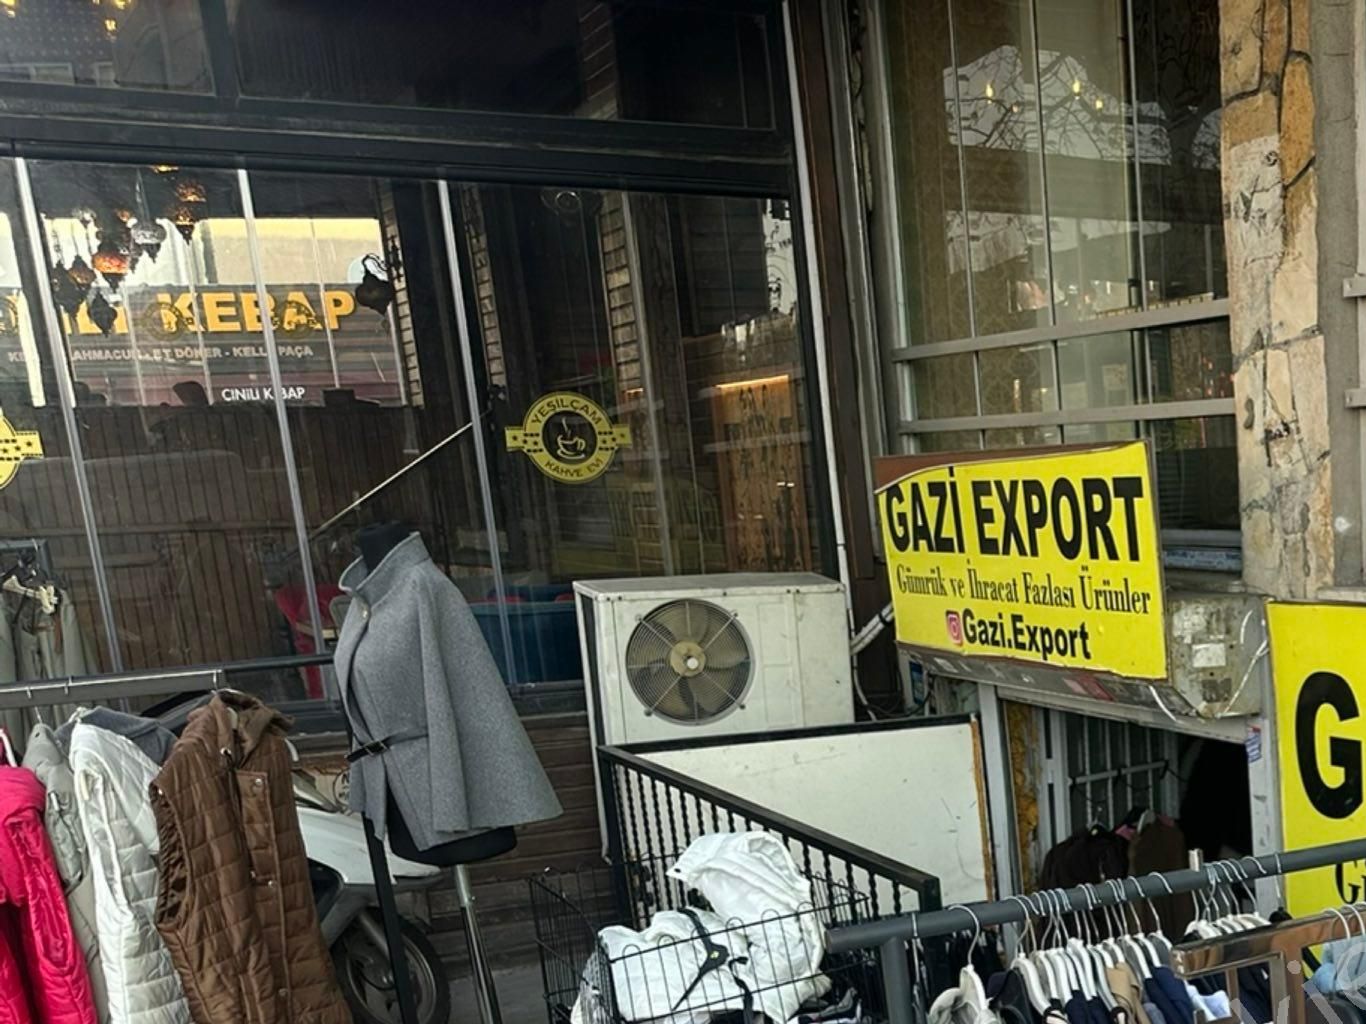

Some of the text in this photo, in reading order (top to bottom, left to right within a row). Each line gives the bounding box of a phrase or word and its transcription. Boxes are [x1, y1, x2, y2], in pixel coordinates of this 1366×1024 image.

[157, 290, 357, 334] KEBAP
[232, 346, 268, 358] KELL
[263, 386, 305, 400] KBAP
[885, 466, 1144, 562] GAZİ EXPORT
[896, 558, 1151, 615] Gümrük ve İhracat Fazlası Ürünler
[962, 608, 1092, 661] Gazi.Export
